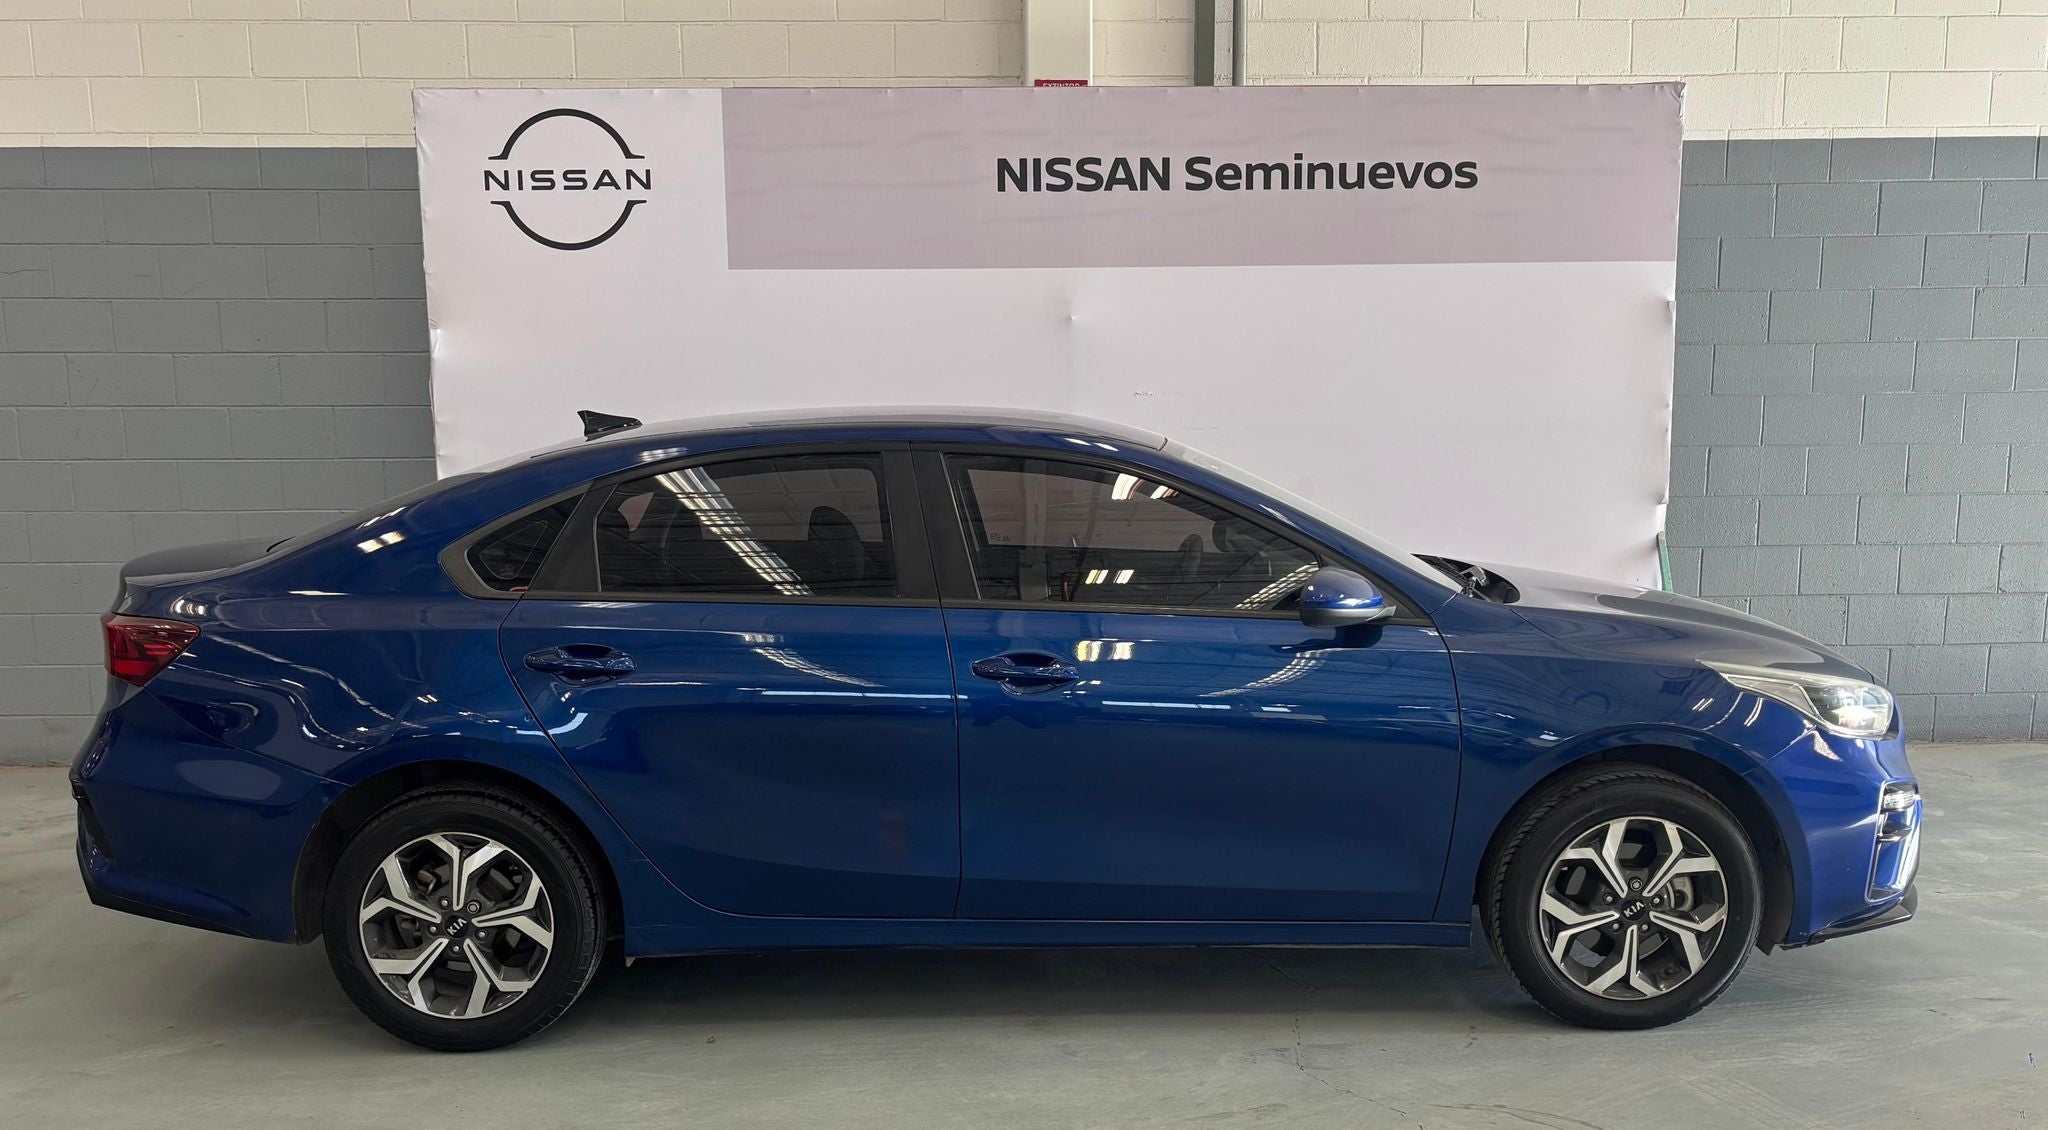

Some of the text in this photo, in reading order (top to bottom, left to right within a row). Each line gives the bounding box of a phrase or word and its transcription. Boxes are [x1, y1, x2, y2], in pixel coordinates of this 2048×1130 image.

[484, 169, 651, 191] NISSAN
[997, 153, 1478, 192] NISSAN Seminuevos
[1623, 901, 1645, 918] KIA
[446, 918, 468, 936] KIA
